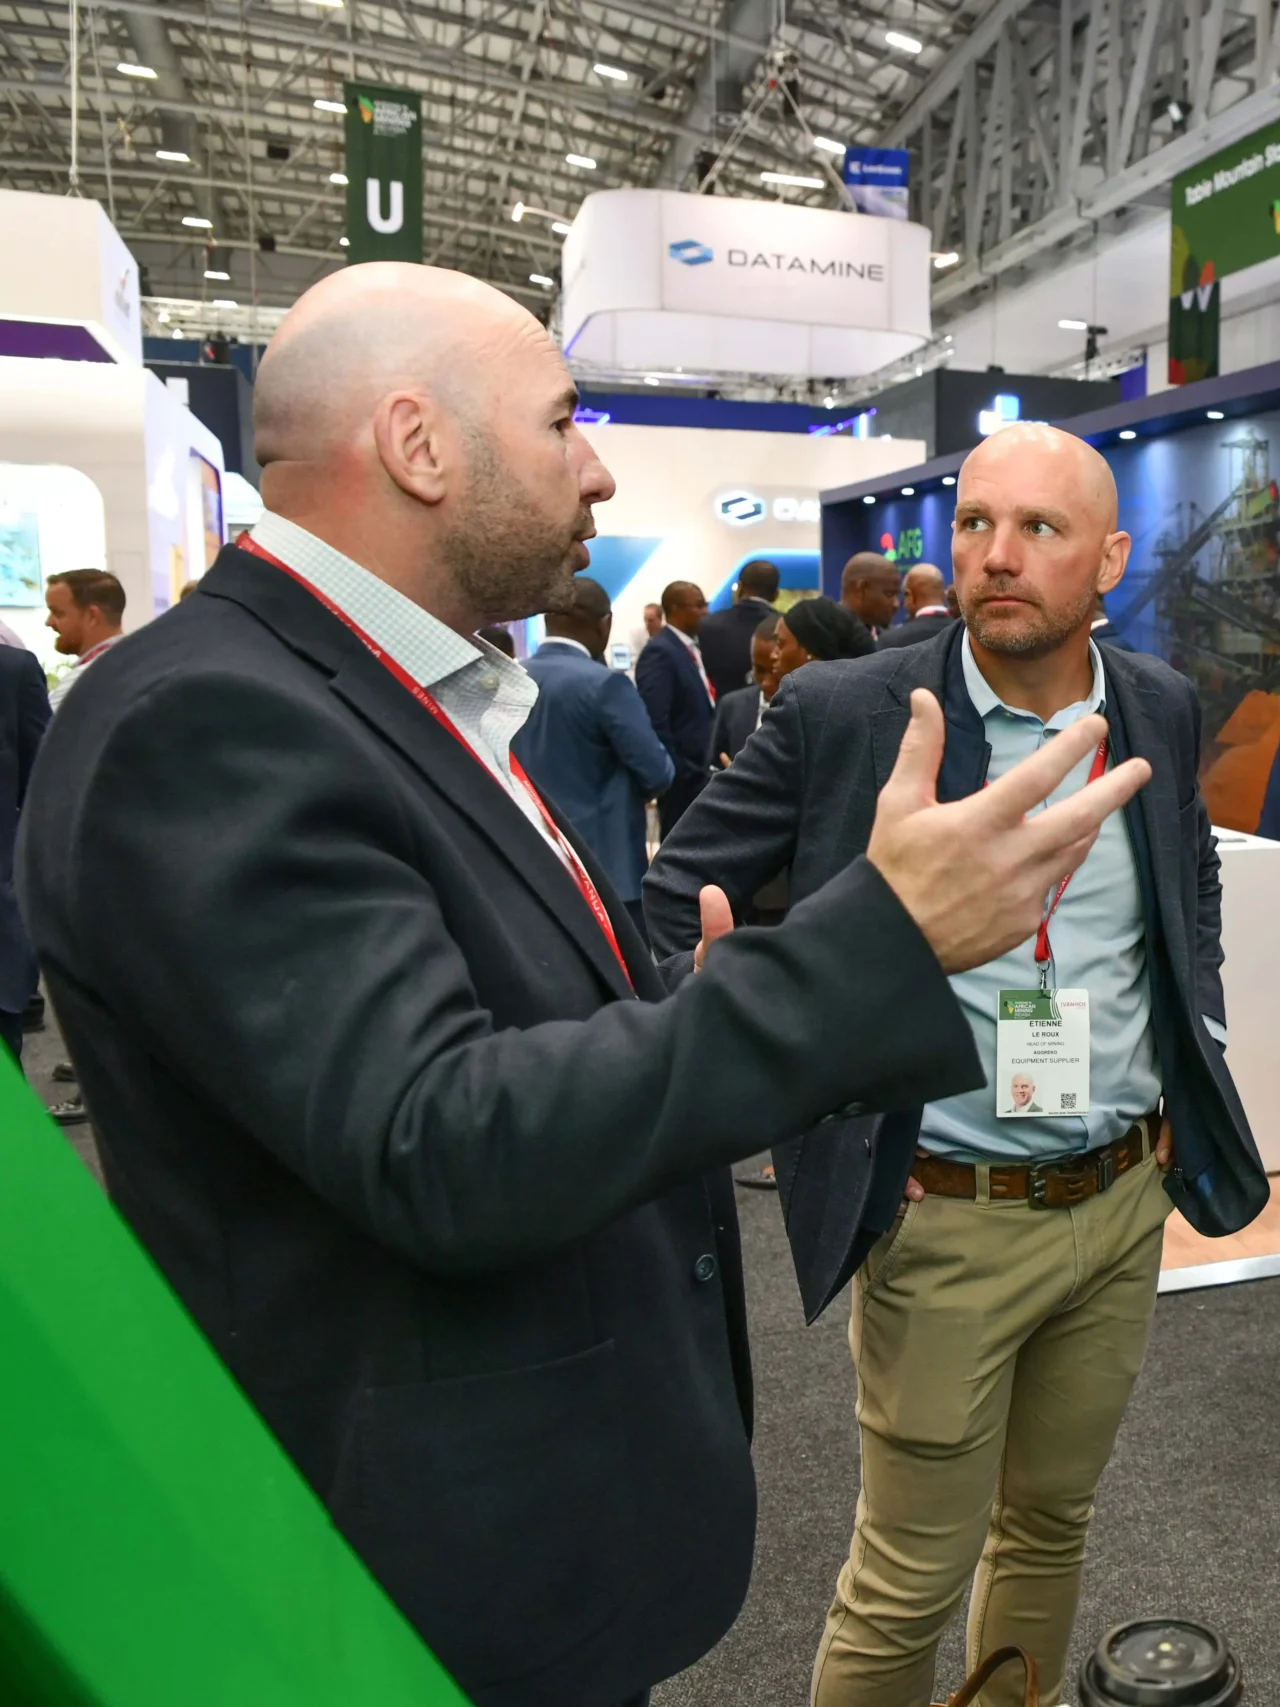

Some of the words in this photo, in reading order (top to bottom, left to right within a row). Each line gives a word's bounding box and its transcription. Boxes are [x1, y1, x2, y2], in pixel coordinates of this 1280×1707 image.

[1185, 180, 1212, 207] Table
[1213, 153, 1264, 192] Mountain
[367, 177, 403, 233] U
[728, 249, 884, 282] DATAMINE
[898, 528, 922, 559] AFG
